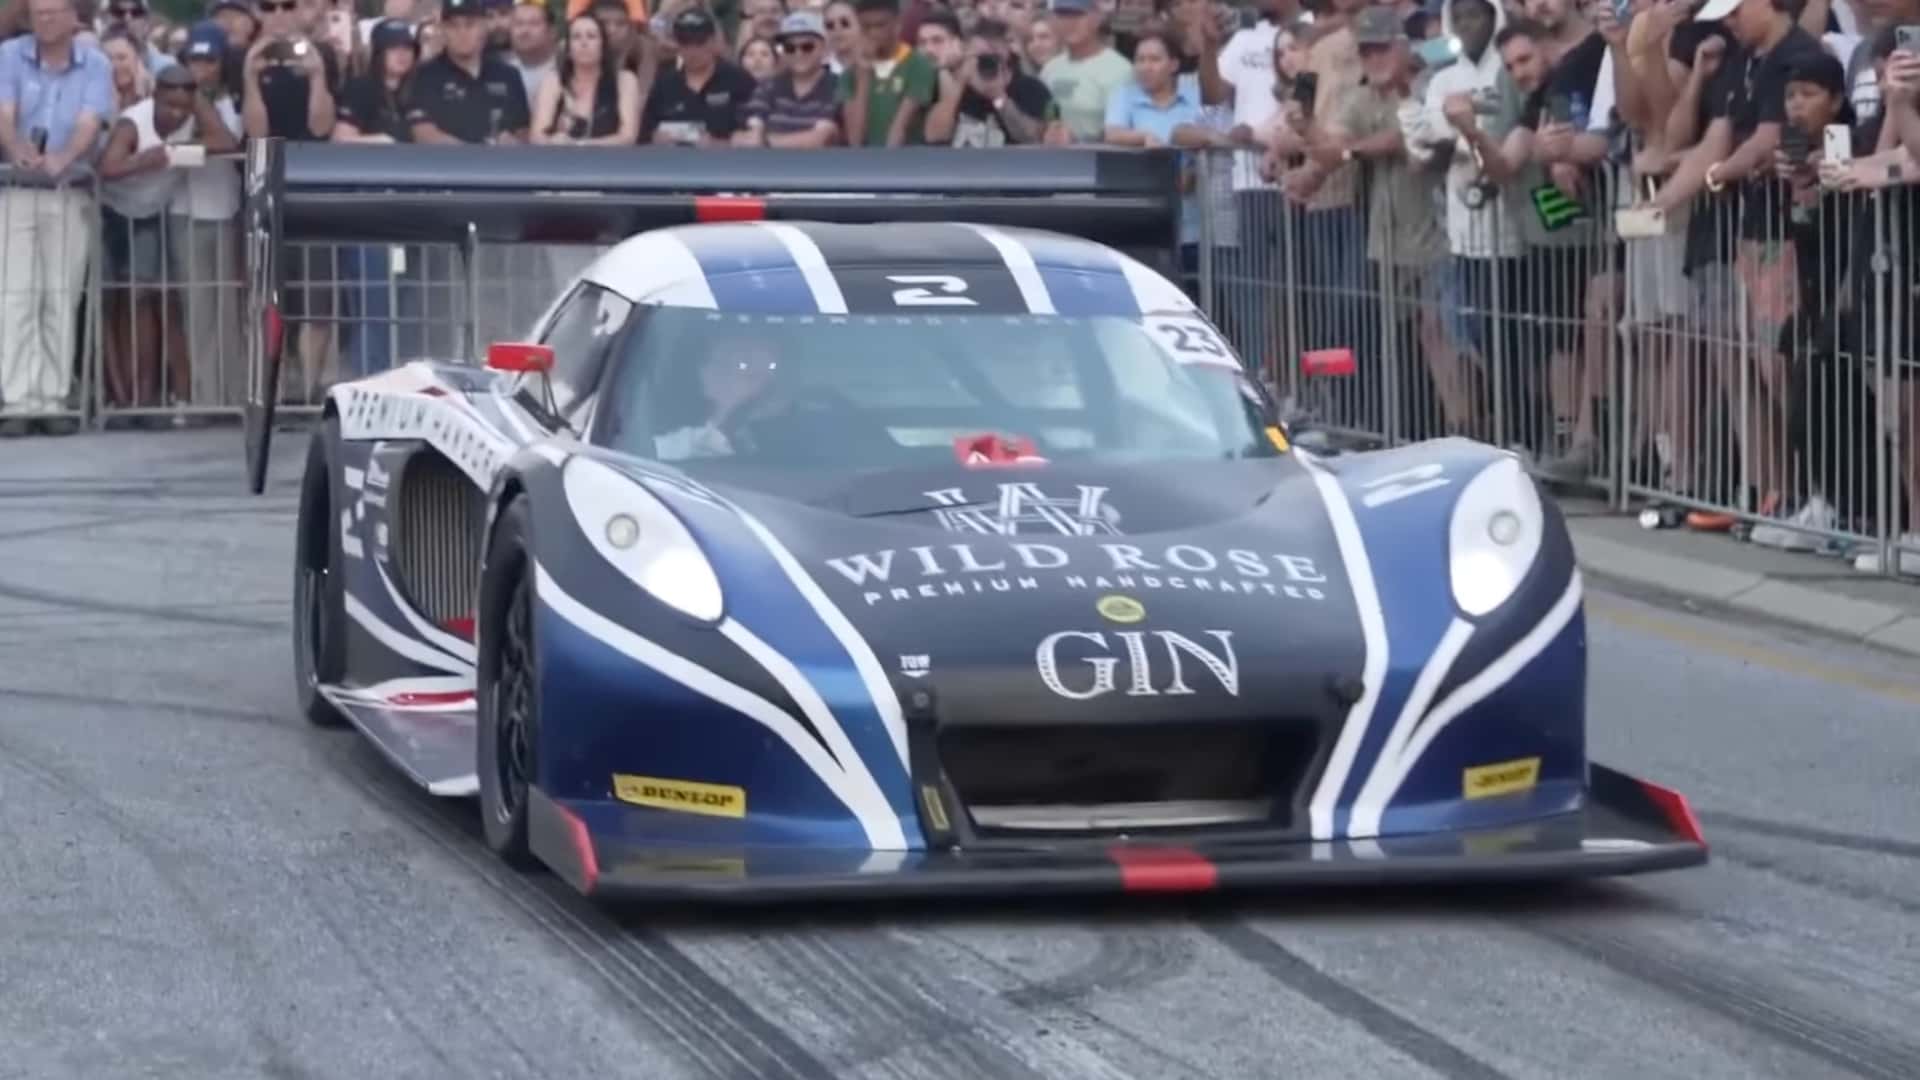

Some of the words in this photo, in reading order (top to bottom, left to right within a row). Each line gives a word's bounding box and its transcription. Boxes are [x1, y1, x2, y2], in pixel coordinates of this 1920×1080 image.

[1157, 324, 1226, 357] 23
[825, 543, 1069, 586] WILD
[1100, 544, 1327, 584] ROSE
[863, 576, 1039, 605] PREMIUM
[1065, 575, 1325, 600] HANDCRAFTED
[1036, 630, 1239, 699] GIN
[642, 785, 734, 807] DUNLOP
